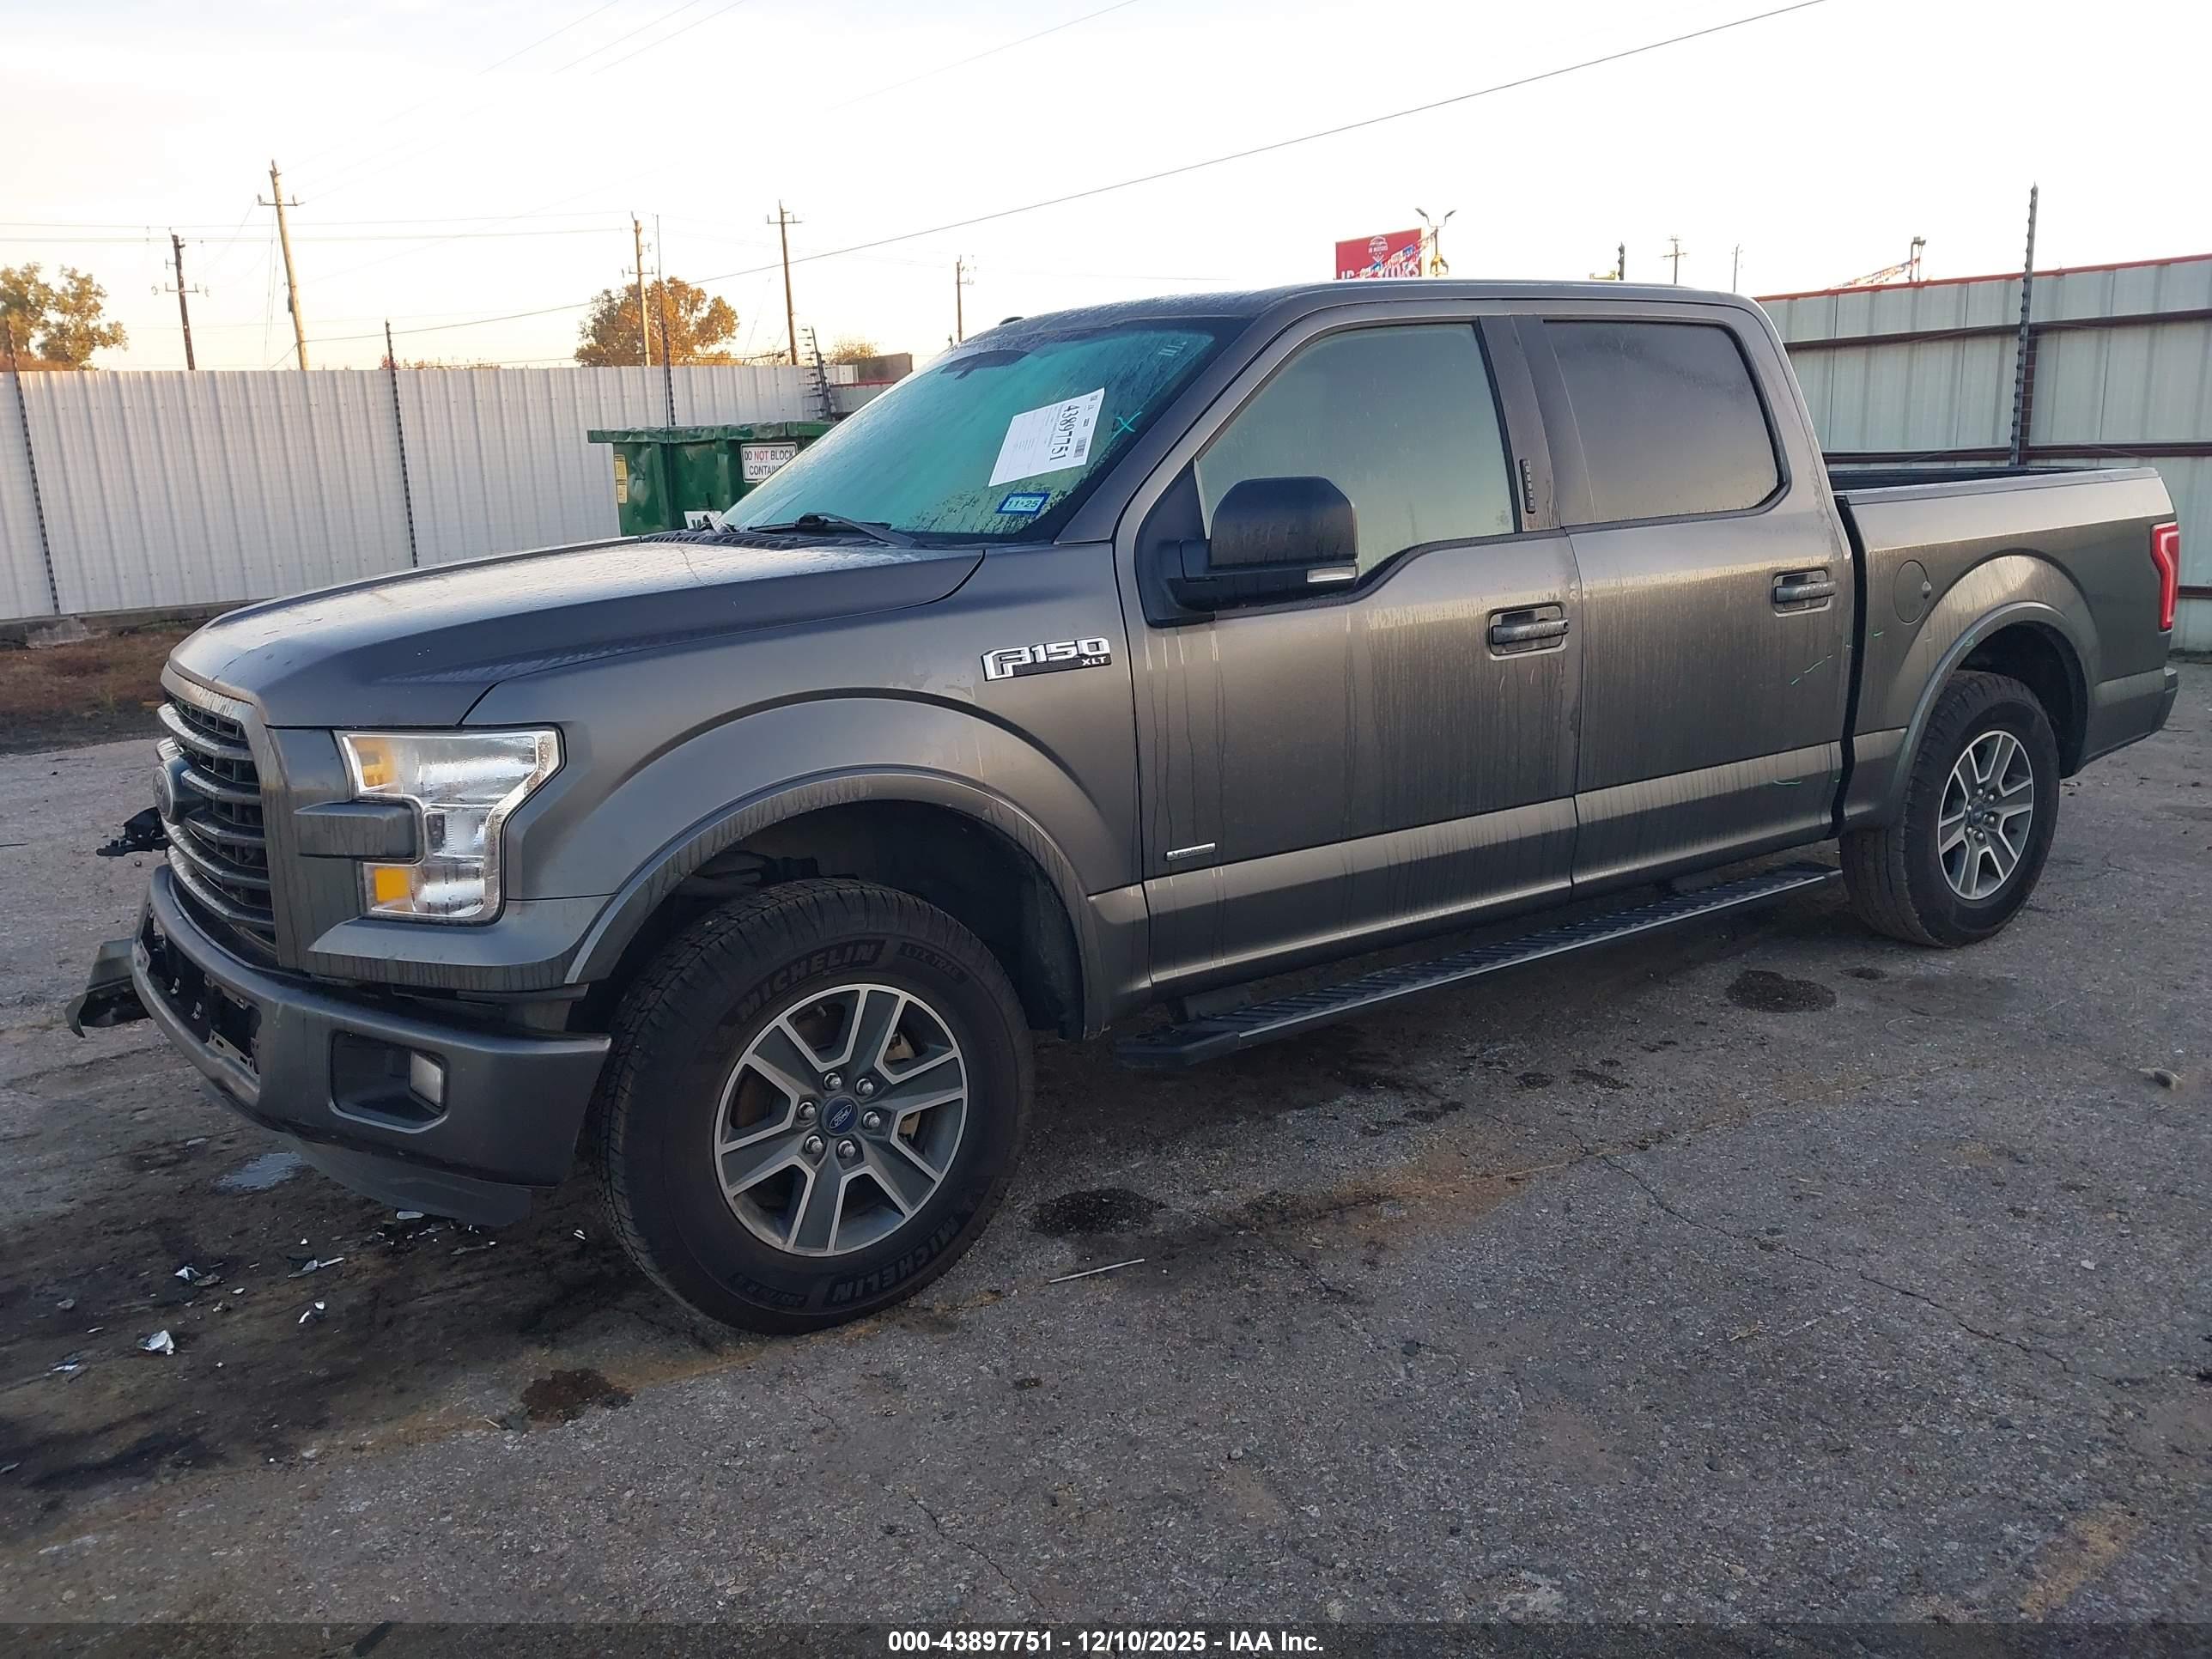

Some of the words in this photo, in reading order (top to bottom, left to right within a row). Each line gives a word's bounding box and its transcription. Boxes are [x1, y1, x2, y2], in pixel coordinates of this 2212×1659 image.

[744, 451, 752, 460] DO
[754, 451, 769, 460] NOT
[770, 451, 793, 460] BLOCK
[1049, 404, 1079, 461] 43897751
[1081, 656, 1106, 666] XLT
[739, 944, 877, 1022] MICHELIN
[833, 1215, 960, 1302] MICHELIN
